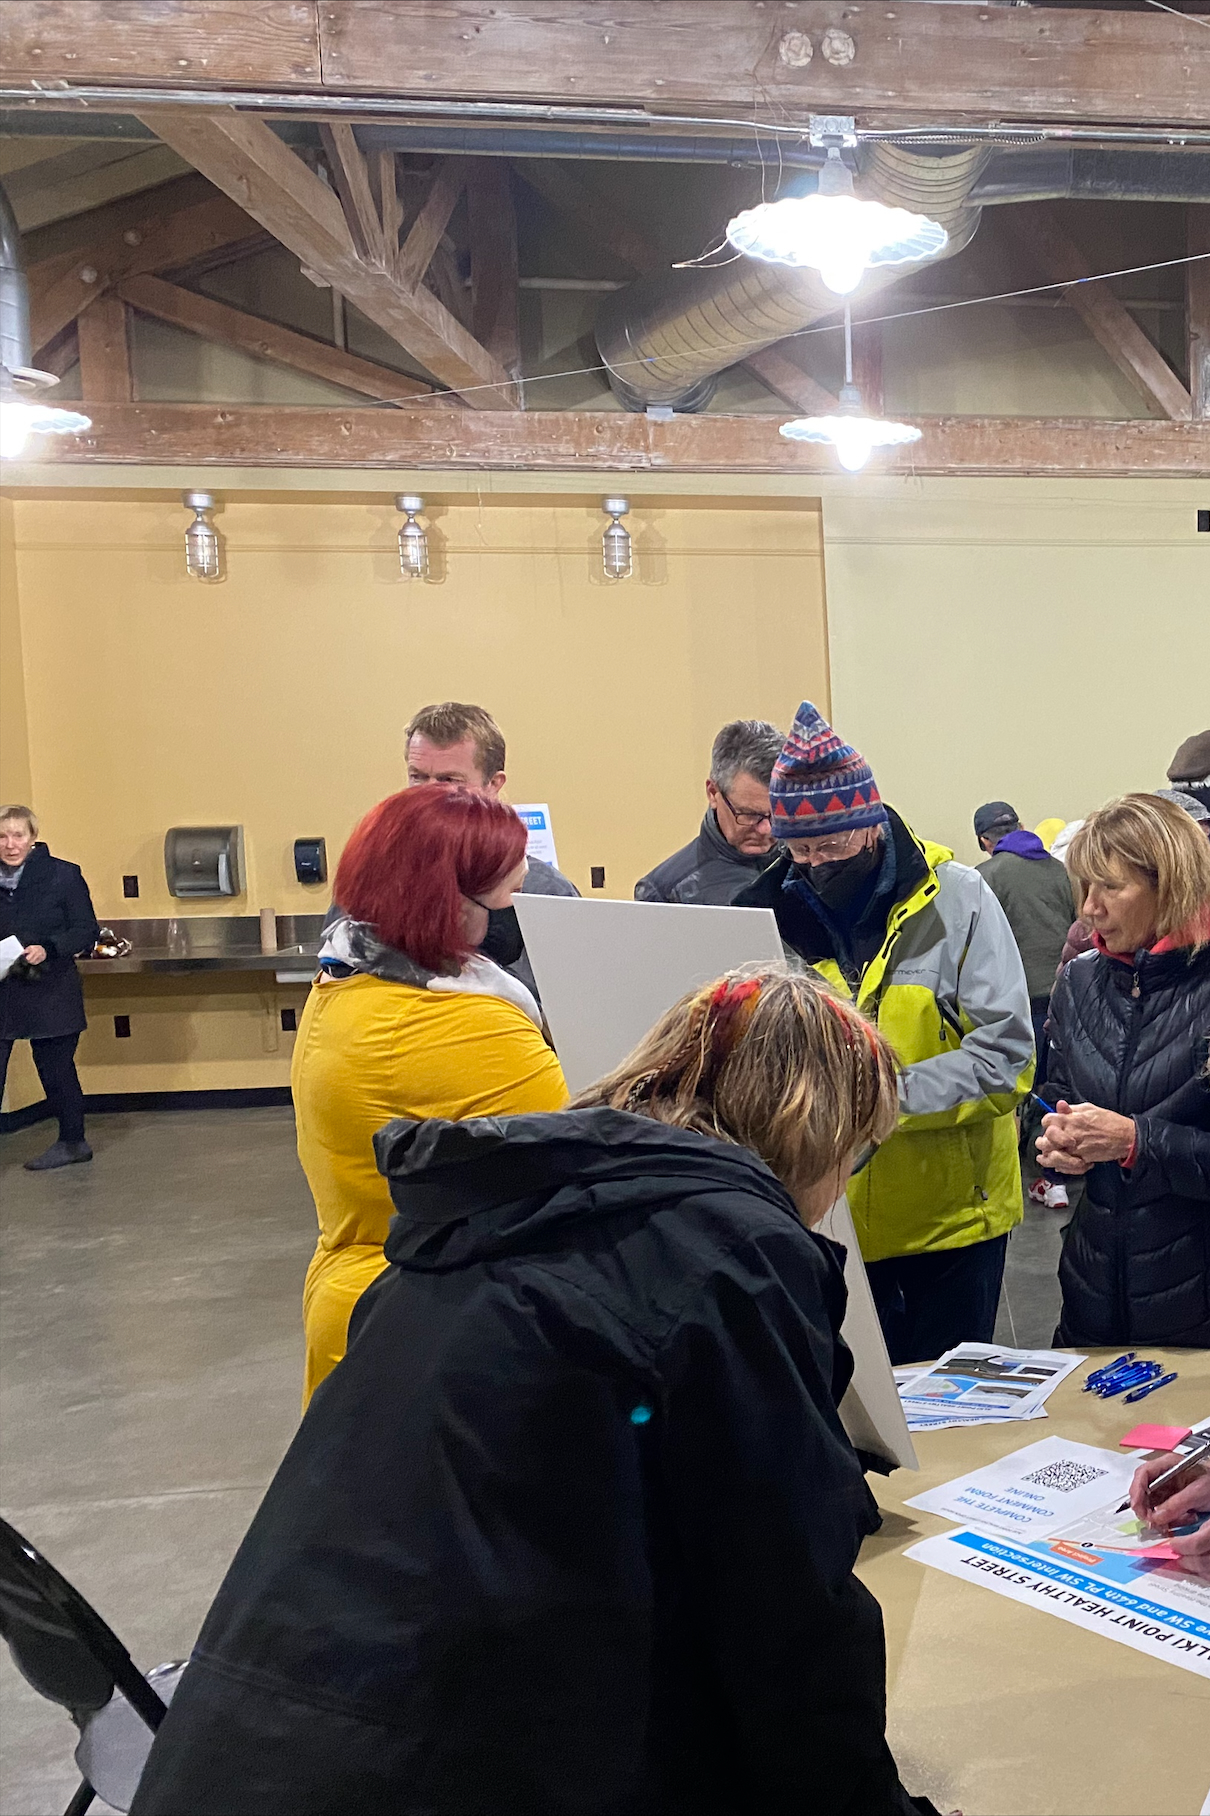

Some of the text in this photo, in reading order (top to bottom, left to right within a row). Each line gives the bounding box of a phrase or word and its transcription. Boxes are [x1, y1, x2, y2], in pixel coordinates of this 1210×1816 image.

[965, 1487, 1054, 1517] COMMENT FORM
[1004, 1487, 1045, 1501] ONLINE
[954, 1496, 1031, 1522] COMPLETE THE
[981, 1543, 1059, 1576] Intersection
[1057, 1546, 1097, 1563] Project Area
[960, 1556, 1031, 1584] STREET
[1055, 1572, 1084, 1586] SW
[1084, 1582, 1105, 1594] PL
[1026, 1582, 1114, 1617] HEALTHY
[1104, 1590, 1138, 1606] 64th
[1135, 1602, 1168, 1617] and
[1110, 1615, 1174, 1642] POINT
[1163, 1615, 1195, 1629] SW
